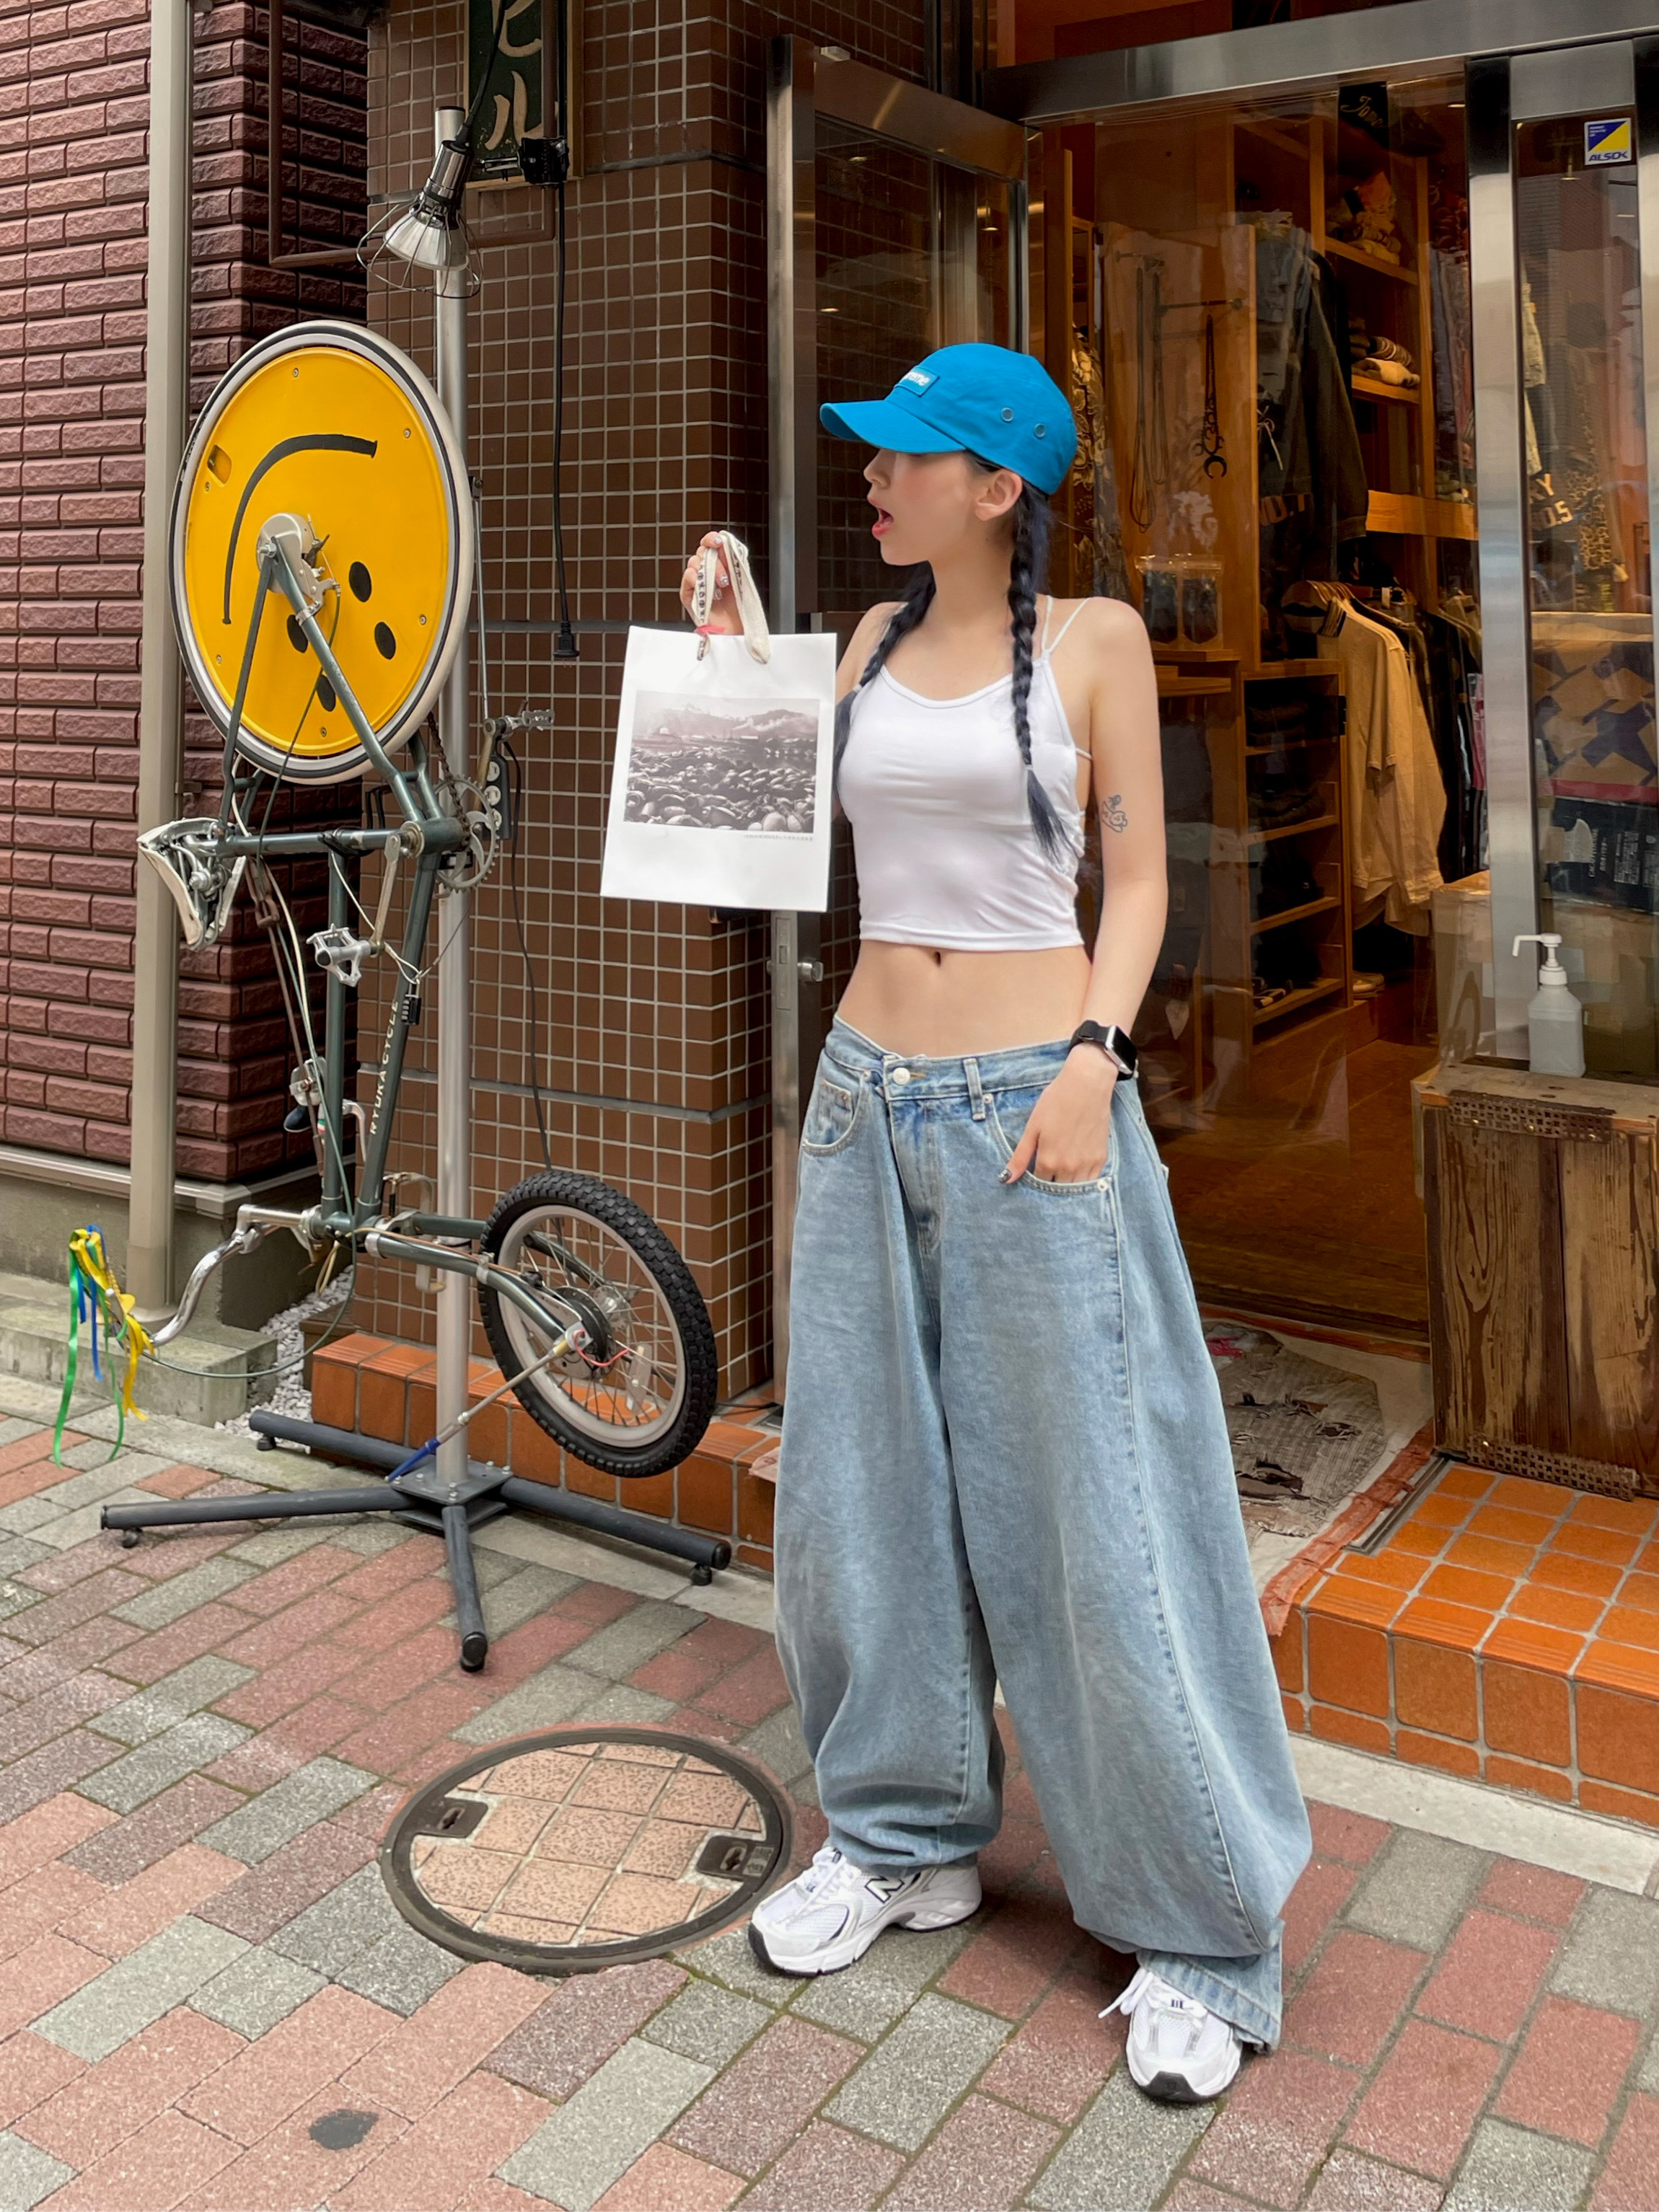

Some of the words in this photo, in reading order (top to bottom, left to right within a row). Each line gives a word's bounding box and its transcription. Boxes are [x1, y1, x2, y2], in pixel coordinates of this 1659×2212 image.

[1588, 151, 1628, 162] ALSOK
[370, 1070, 387, 1134] RYUKA
[382, 1000, 398, 1065] CYCLE
